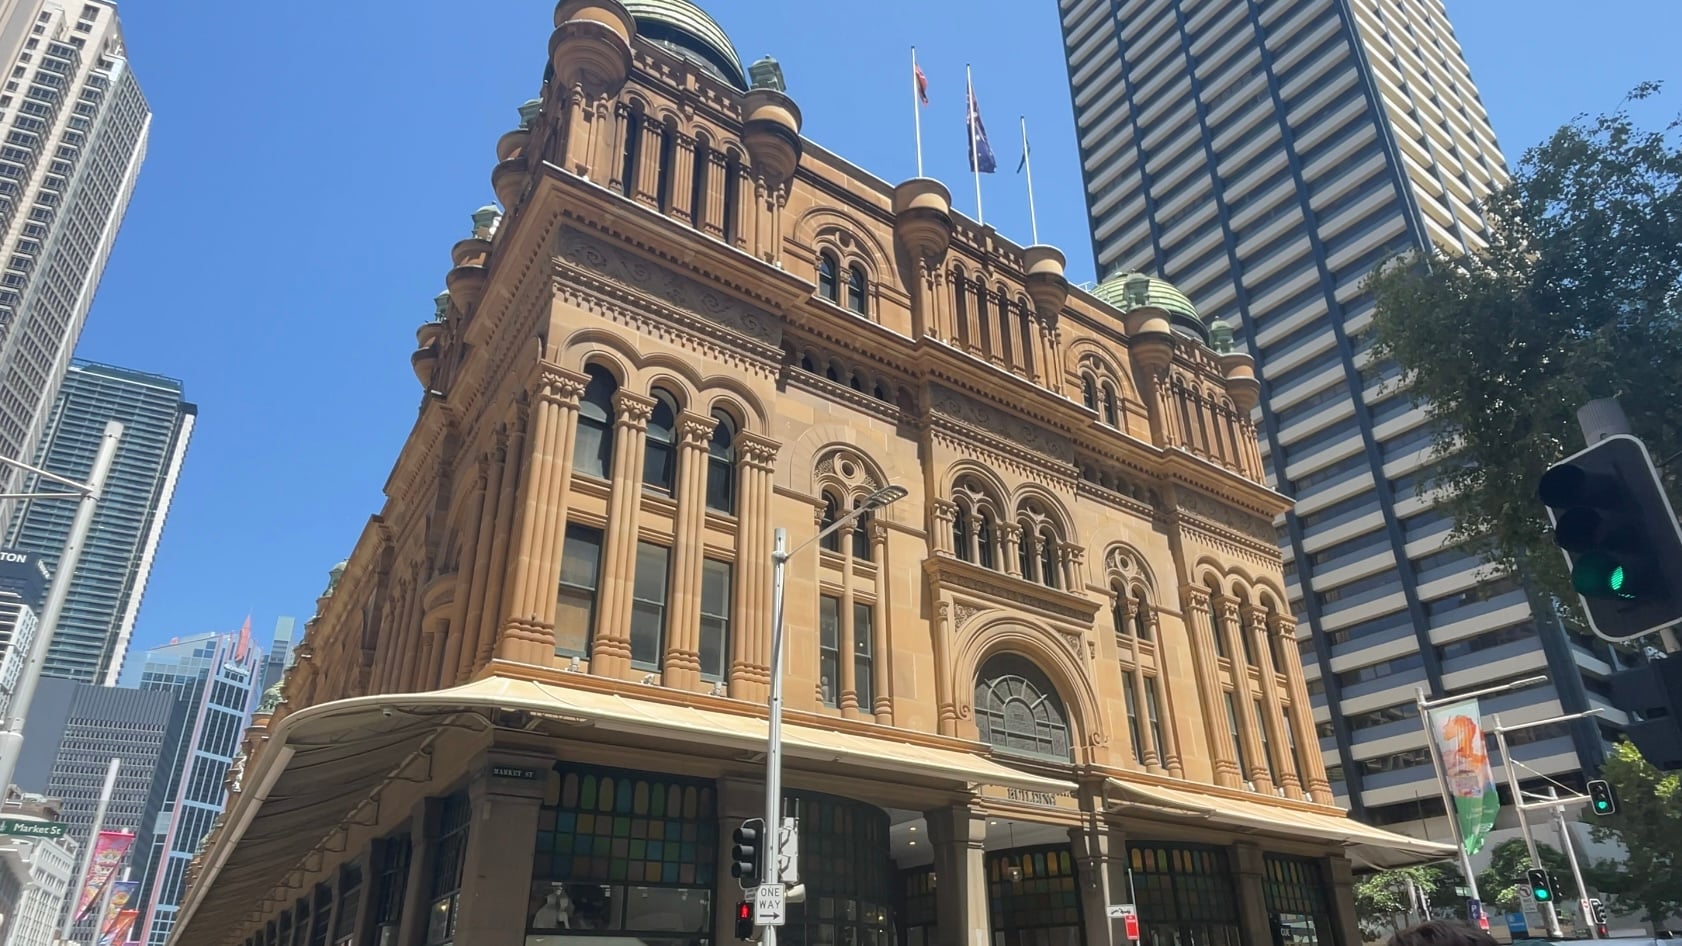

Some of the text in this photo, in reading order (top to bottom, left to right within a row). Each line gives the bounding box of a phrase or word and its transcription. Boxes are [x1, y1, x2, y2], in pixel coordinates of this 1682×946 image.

[494, 768, 522, 777] MARKET
[13, 823, 61, 835] Market St
[760, 887, 780, 897] ONE
[759, 899, 781, 909] WAY
